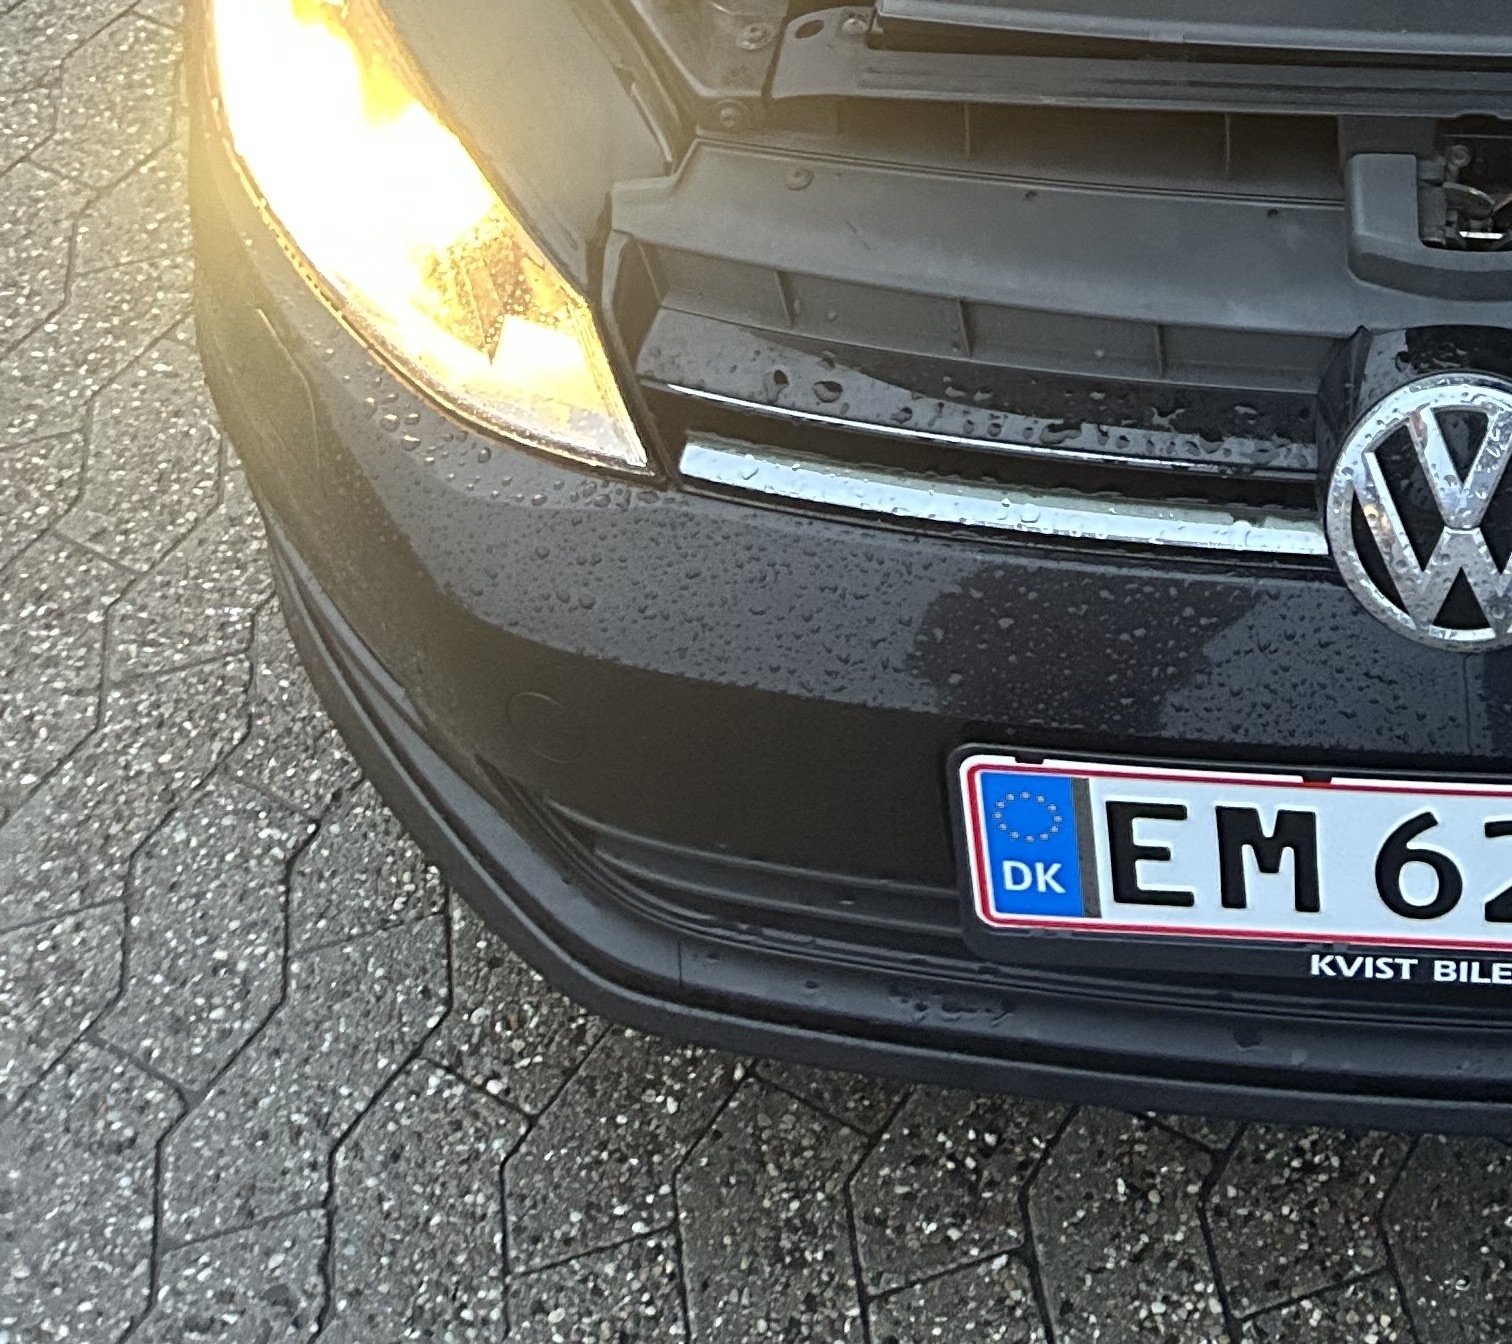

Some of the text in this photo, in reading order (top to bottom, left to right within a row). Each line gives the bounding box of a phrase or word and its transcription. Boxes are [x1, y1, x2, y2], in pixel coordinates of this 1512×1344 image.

[1105, 799, 1321, 913] EM
[1003, 860, 1066, 894] DK
[1310, 954, 1419, 980] KVIST
